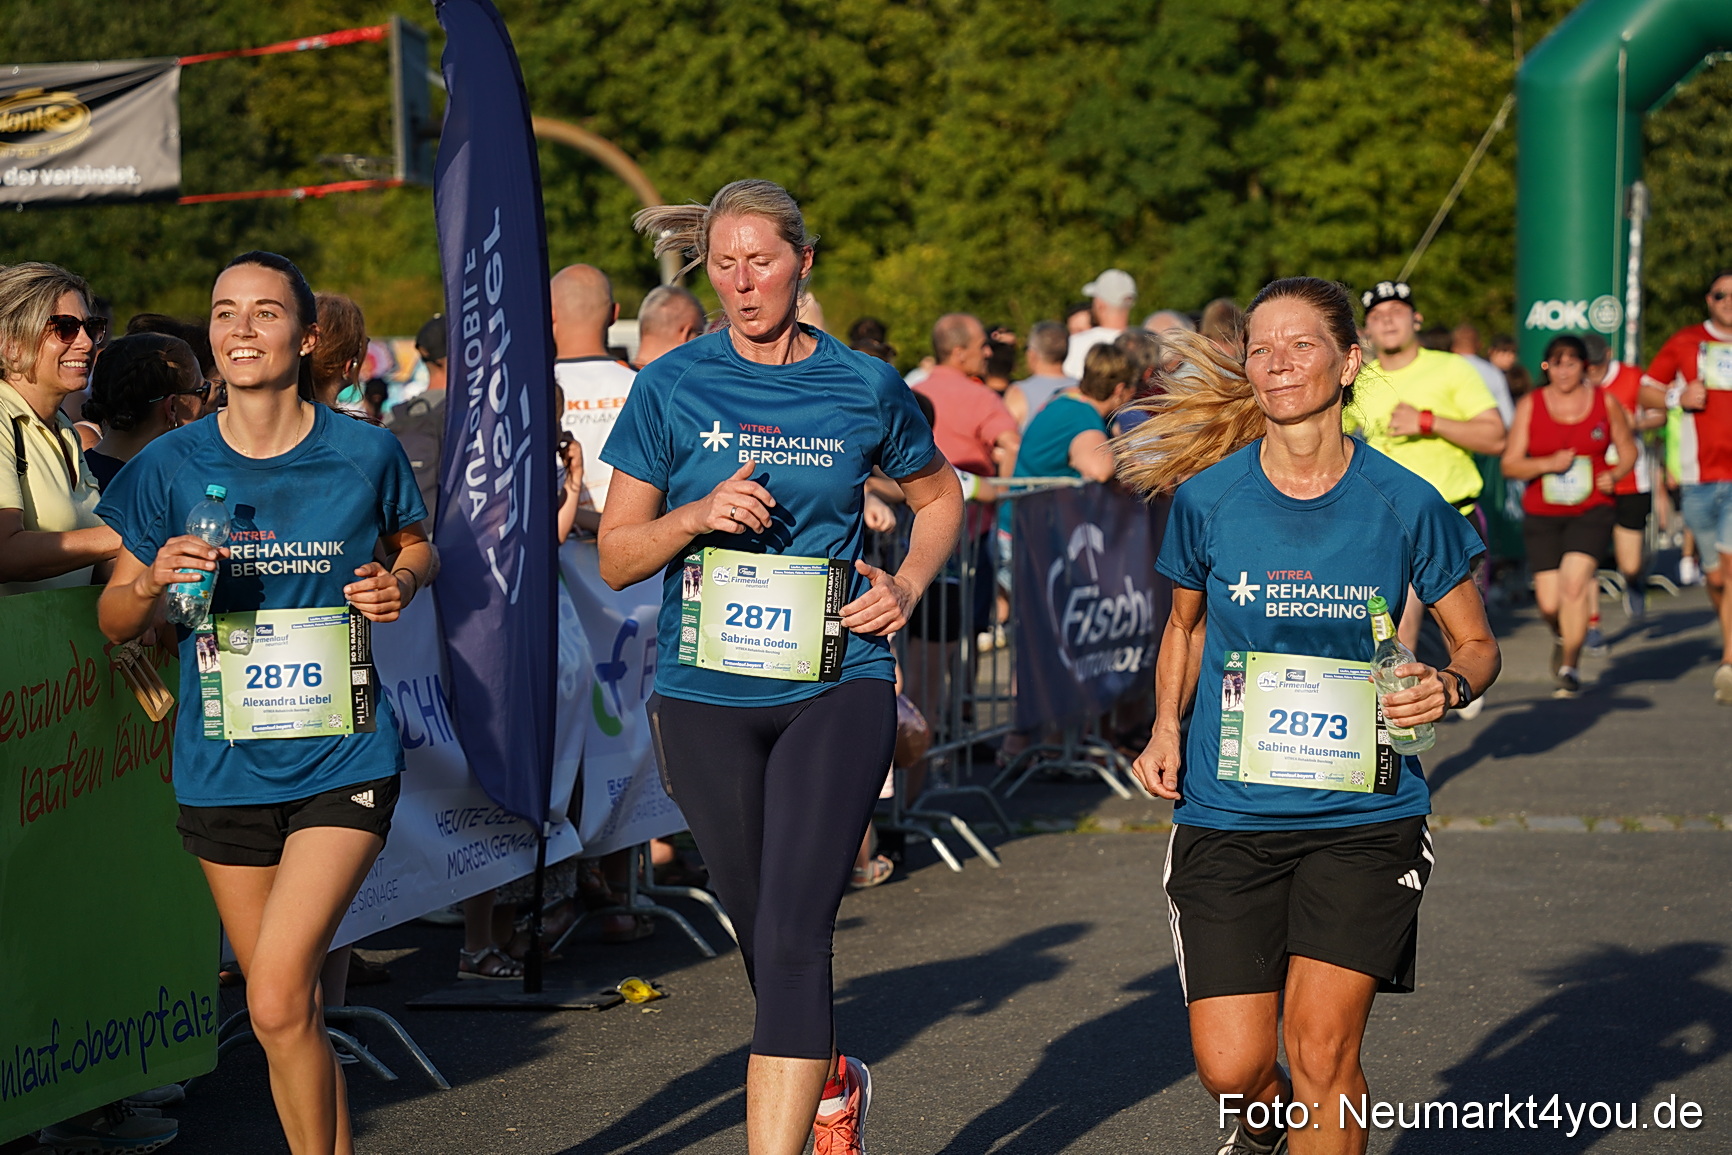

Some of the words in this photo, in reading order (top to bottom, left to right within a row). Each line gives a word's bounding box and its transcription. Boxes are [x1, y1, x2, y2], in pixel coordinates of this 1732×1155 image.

[1525, 300, 1589, 331] AOK
[739, 423, 781, 434] VITREA
[739, 433, 845, 453] REHAKLINIK
[738, 450, 833, 468] BERCHING
[230, 530, 276, 542] VITREA
[230, 541, 345, 560] REHAKLINIK
[685, 553, 701, 561] AOK
[231, 559, 331, 577] BERCHING
[1266, 570, 1313, 581] VITREA
[731, 576, 770, 585] Firmenlauf
[827, 566, 835, 596] RABATT
[1266, 583, 1380, 601] REHAKLINIK
[725, 602, 792, 633] 2871
[1265, 602, 1367, 619] BERCHING
[250, 634, 289, 645] Firmenlauf
[720, 632, 761, 647] Sabrina
[763, 637, 798, 650] Godon
[824, 638, 835, 674] HILTL
[1225, 660, 1244, 668] AOK
[245, 662, 323, 690] 2876
[1279, 681, 1320, 690] Firmenlauf
[242, 696, 297, 708] Alexandra
[299, 693, 332, 705] Liebel
[355, 687, 366, 725] HILTL
[1268, 708, 1348, 740] 2873
[1257, 740, 1296, 754] Sabine
[1300, 745, 1361, 760] Hausmann
[1379, 747, 1389, 785] HILTL
[435, 807, 489, 838] HEUTE
[447, 838, 493, 879] MORGEN
[358, 878, 399, 911] SIGNAGE
